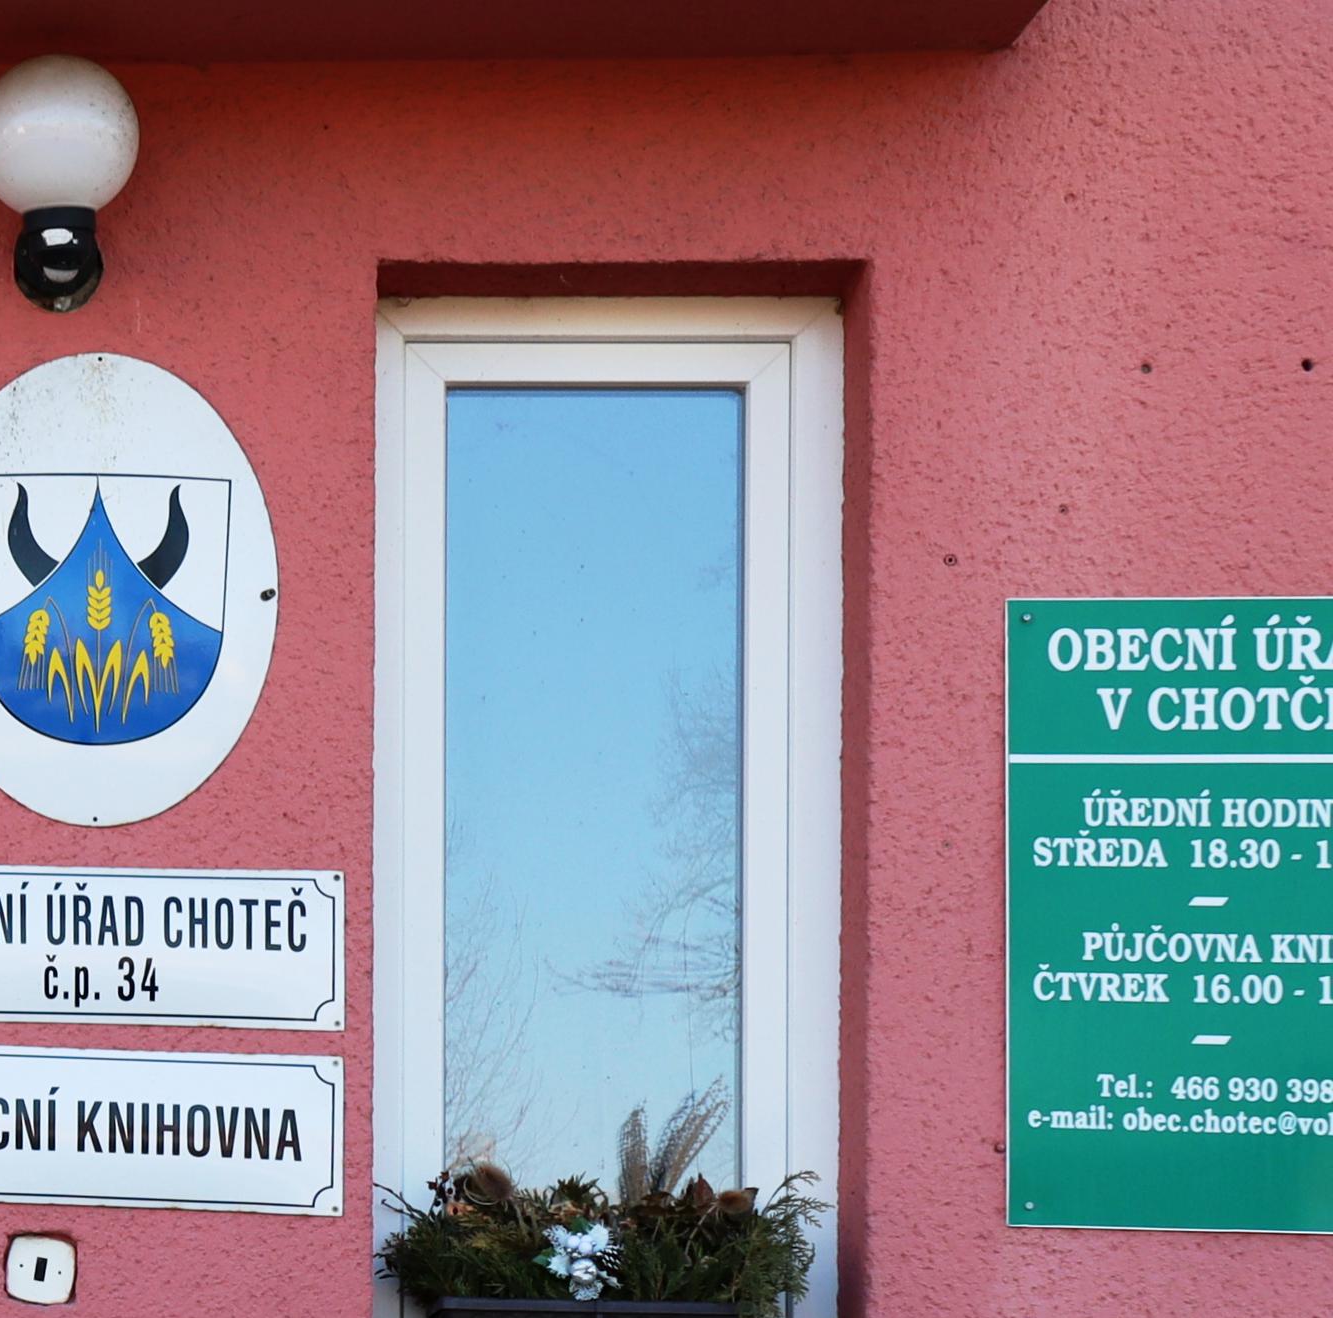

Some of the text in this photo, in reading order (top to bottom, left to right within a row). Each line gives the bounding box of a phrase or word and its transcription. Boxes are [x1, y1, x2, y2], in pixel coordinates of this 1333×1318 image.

[1047, 614, 1333, 672] OBECNÍ ÚŘ
[1096, 687, 1132, 730] V
[1082, 788, 1212, 827] ÚŘEDNÍ
[1033, 829, 1168, 868] STŘEDA
[1190, 838, 1280, 869] 18.30
[46, 882, 145, 947] ÚŘAD
[163, 887, 308, 953] CHOTEČ
[1082, 923, 1262, 963] PŮJČOVNA
[44, 954, 159, 1008] č.p. 34
[1033, 963, 1170, 1002] ČTVREK
[1193, 974, 1283, 1004] 16.00
[1096, 1074, 1333, 1103] Tel.: 466 930 398
[76, 1101, 303, 1161] KNIHOVNA
[1028, 1105, 1113, 1130] e-mail:
